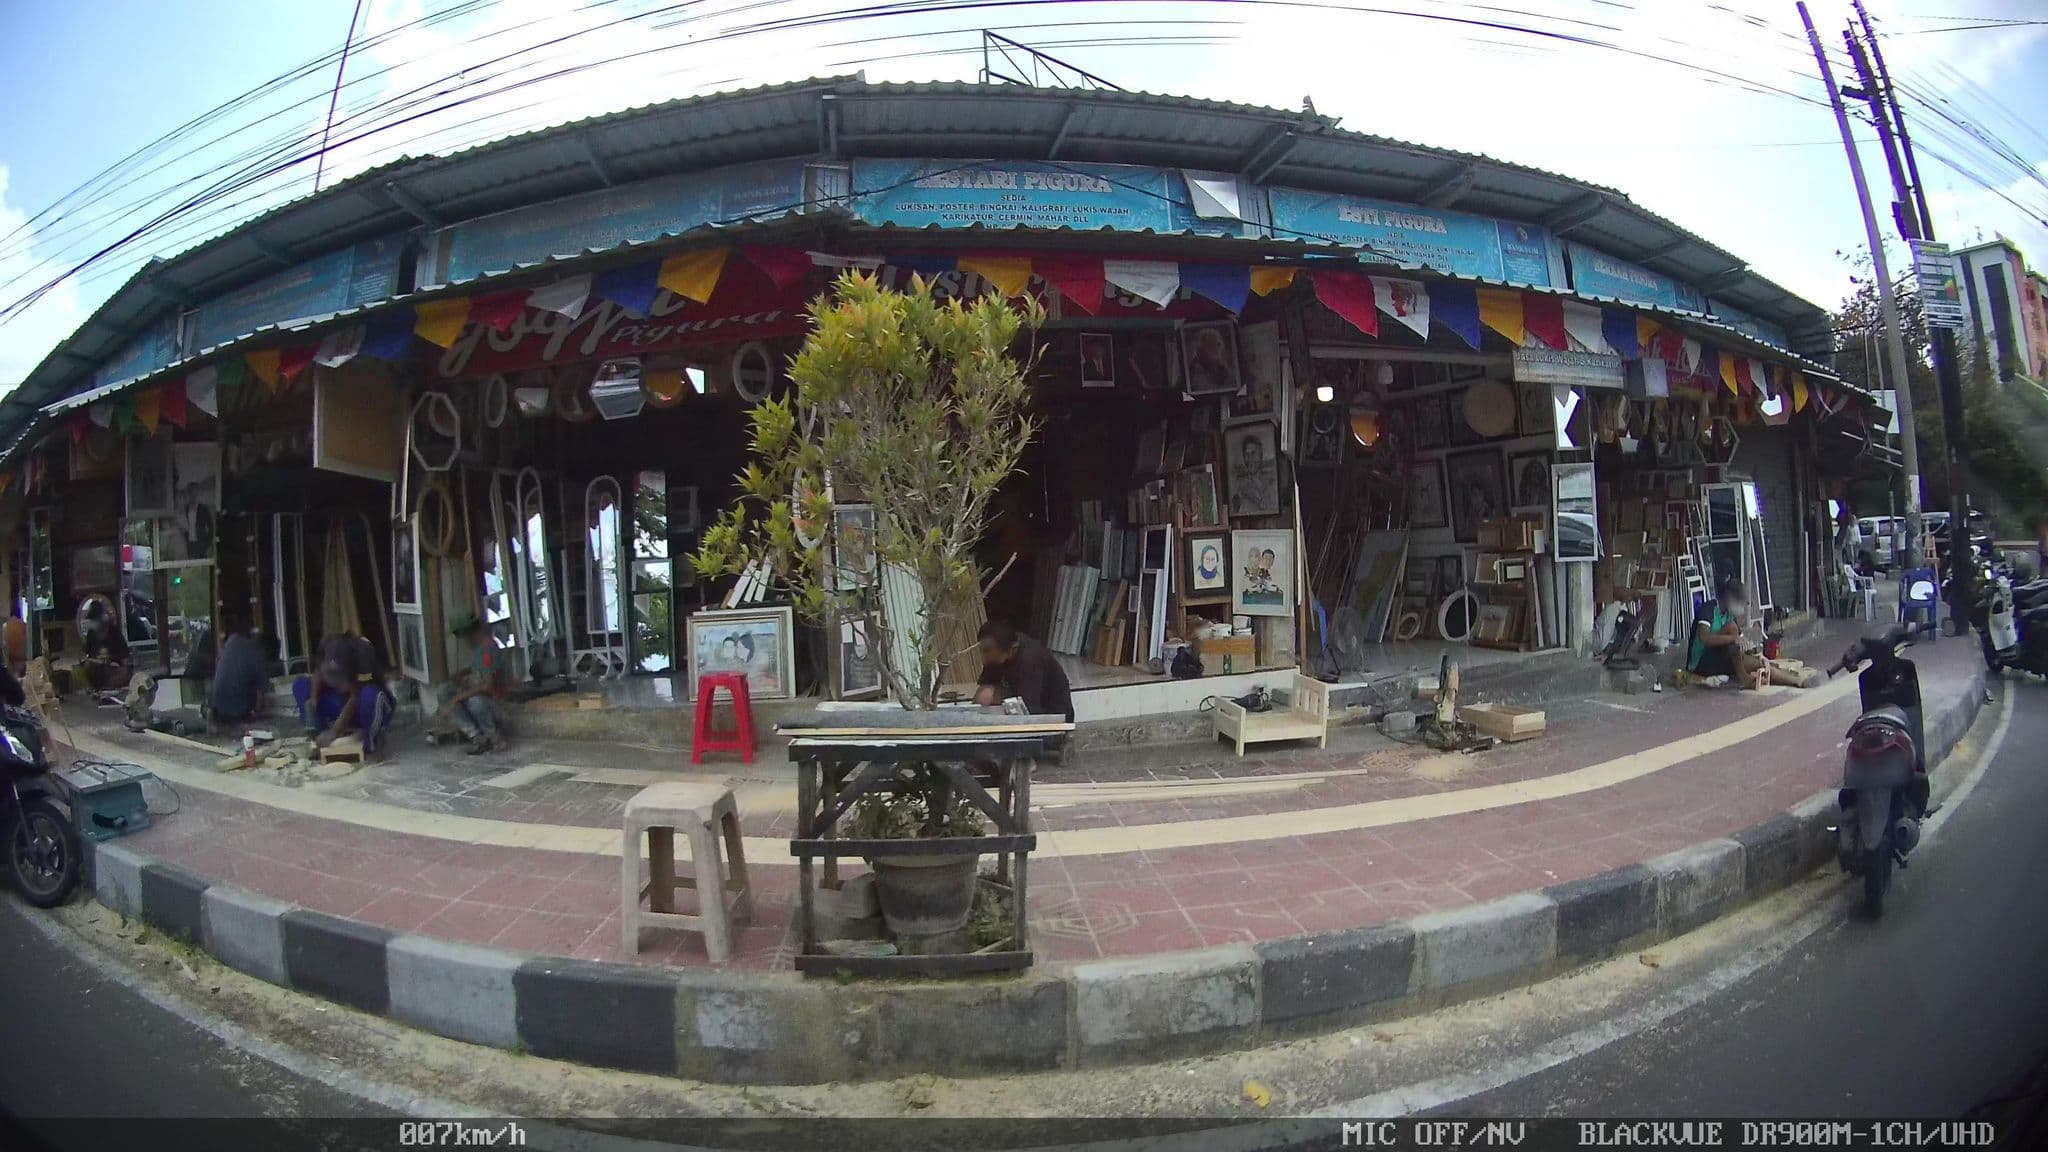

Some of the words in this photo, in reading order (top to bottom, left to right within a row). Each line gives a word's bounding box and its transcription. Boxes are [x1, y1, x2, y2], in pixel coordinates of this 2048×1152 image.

[914, 169, 1018, 190] LESTARI
[1023, 171, 1114, 193] PIGURA
[1099, 207, 1130, 215] WAJAH
